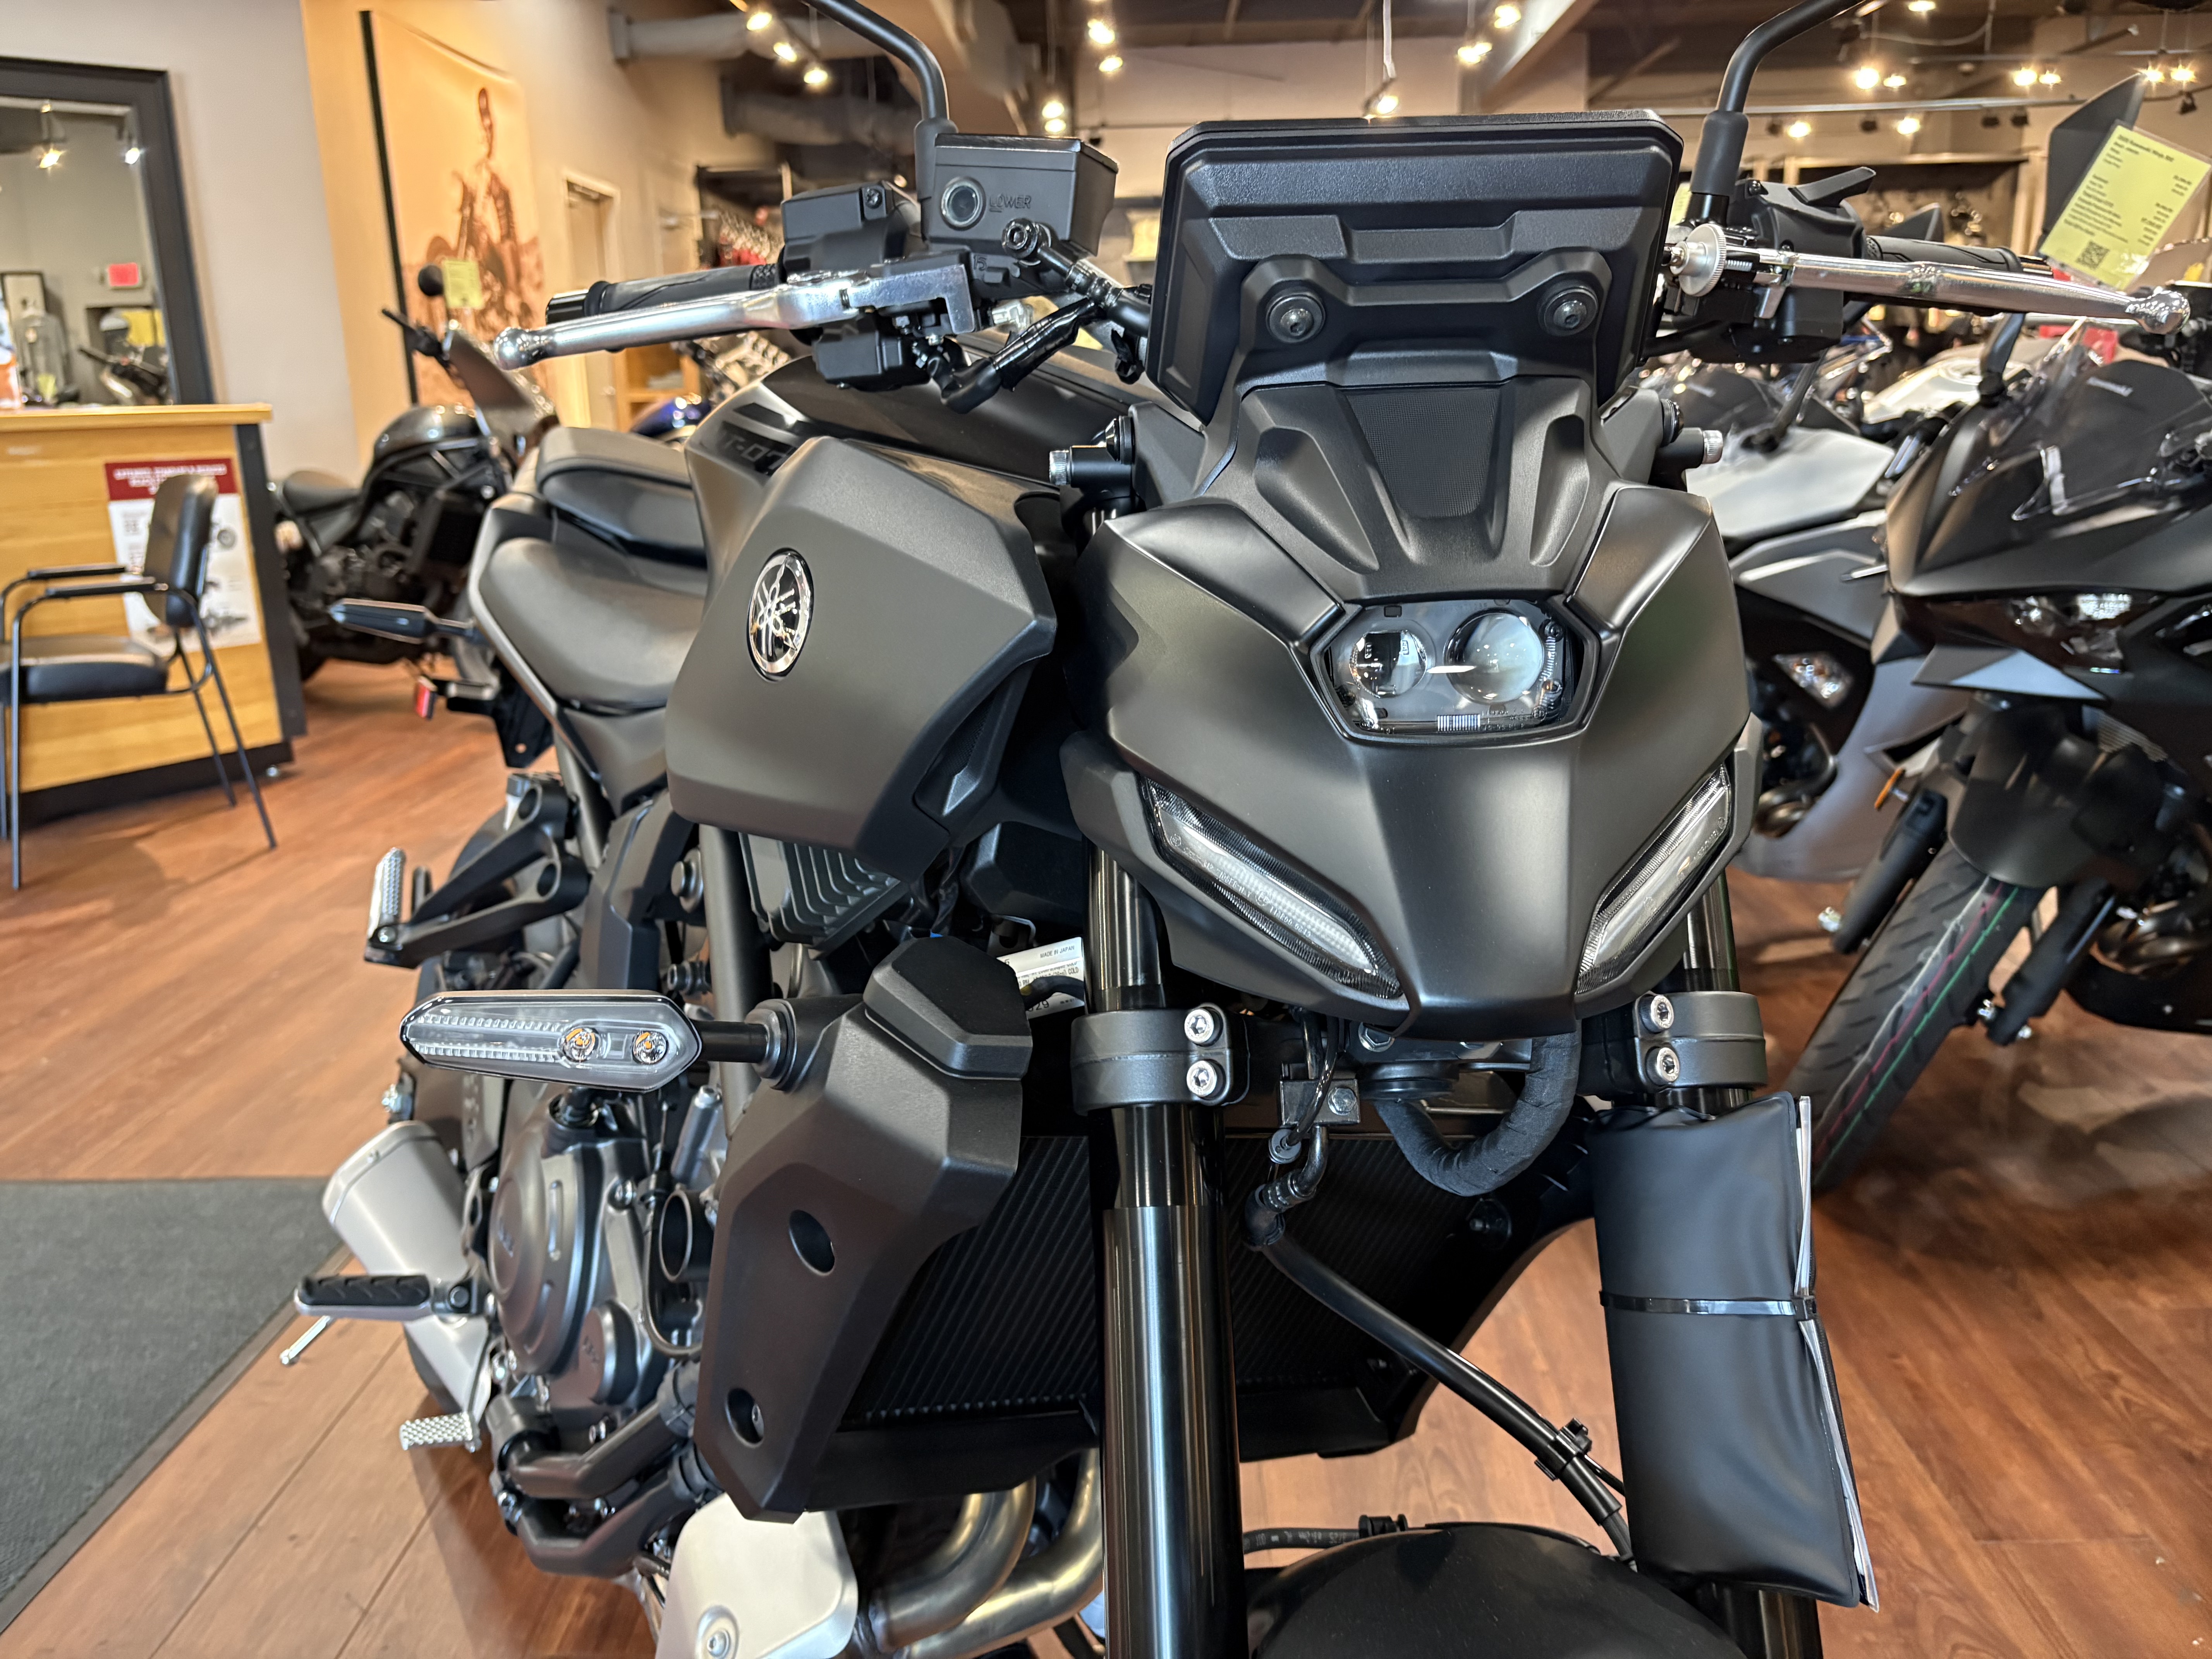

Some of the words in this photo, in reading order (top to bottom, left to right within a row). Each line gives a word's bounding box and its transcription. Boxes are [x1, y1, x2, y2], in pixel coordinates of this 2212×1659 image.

[989, 194, 1031, 210] LOWER
[974, 256, 987, 271] 15
[1060, 945, 1075, 953] JAPAN
[1068, 967, 1079, 975] COLD
